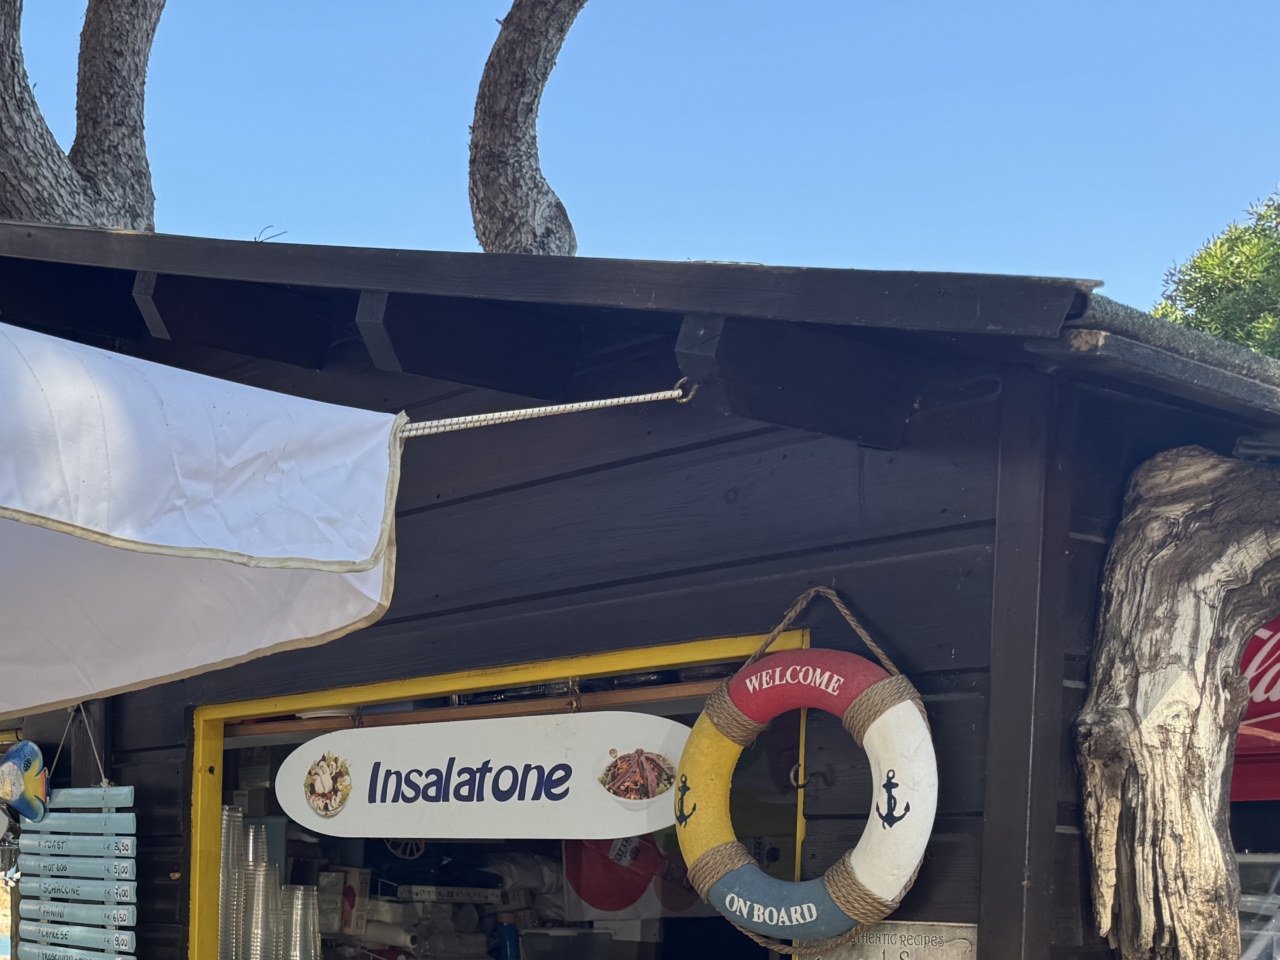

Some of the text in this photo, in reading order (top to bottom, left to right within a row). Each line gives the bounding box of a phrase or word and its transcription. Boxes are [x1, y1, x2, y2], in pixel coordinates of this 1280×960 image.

[744, 665, 845, 696] WELCOME
[367, 757, 573, 805] Insalatone
[114, 842, 130, 854] 3,50
[114, 864, 129, 876] 5,00
[725, 893, 818, 926] ON BOARD
